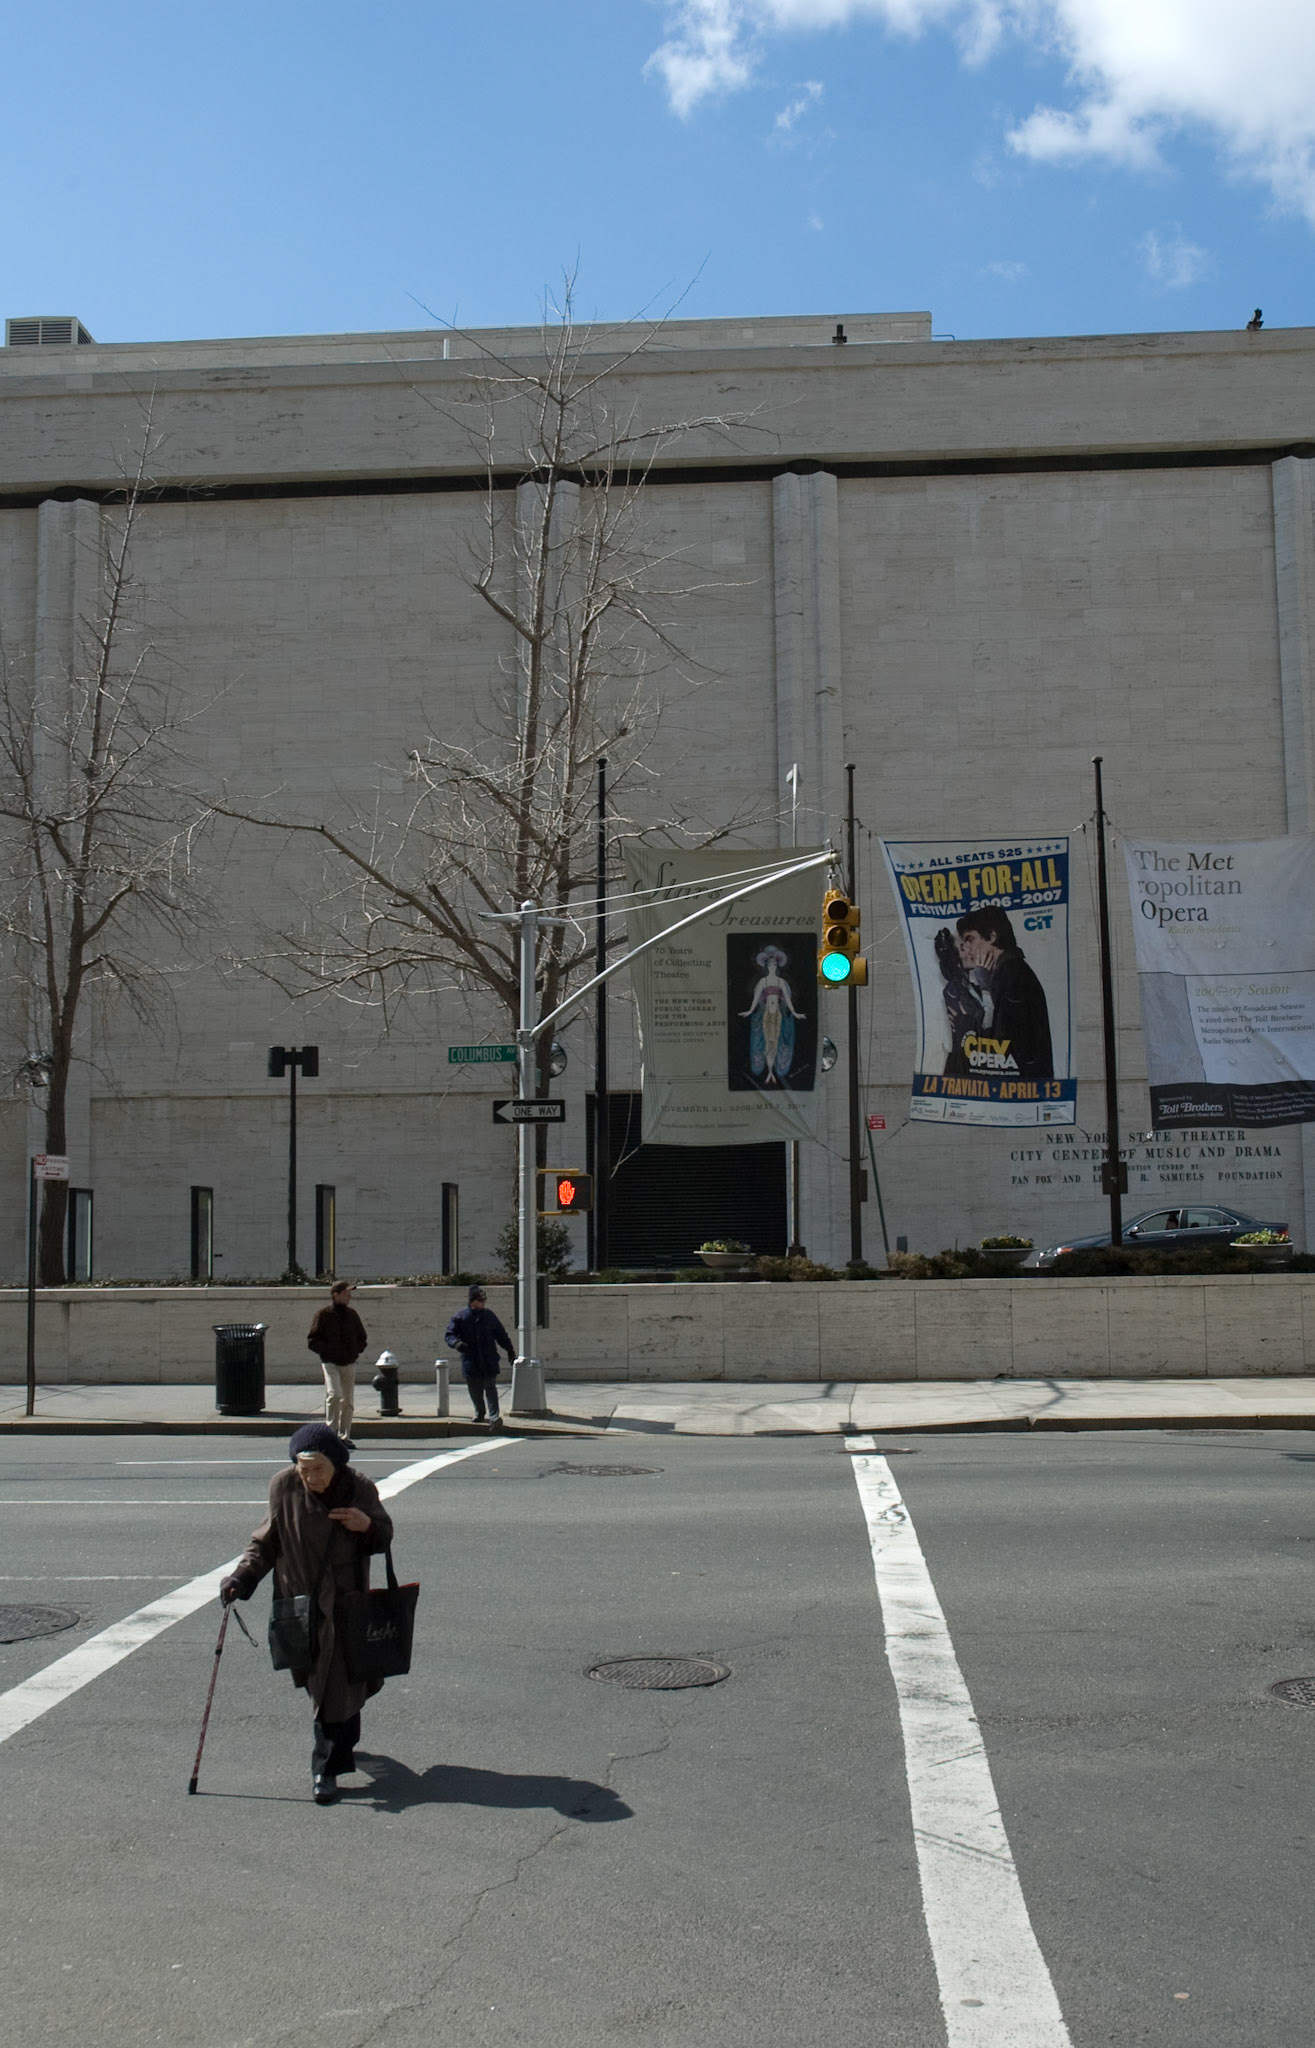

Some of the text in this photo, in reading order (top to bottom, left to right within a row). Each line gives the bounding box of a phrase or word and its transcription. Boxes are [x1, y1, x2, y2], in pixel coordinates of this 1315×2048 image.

[929, 847, 1022, 868] ALL SEATS $25
[1134, 850, 1235, 872] The Met
[633, 861, 724, 900] Stars
[900, 858, 1062, 903] OPERA-FOR-ALL
[1137, 874, 1242, 903] ropolitan
[710, 899, 816, 926] Treasures
[910, 902, 967, 916] FESTIVAL
[1141, 899, 1209, 928] Opera
[656, 946, 693, 954] 75 Years
[666, 959, 711, 968] Collecting
[654, 971, 689, 979] Theatre
[1248, 983, 1289, 996] Season
[1197, 1005, 1209, 1013] The
[1243, 1004, 1277, 1012] Broadcast
[1200, 1022, 1315, 1036] Metropolitan Opera International
[964, 1034, 1011, 1058] CITY
[1222, 1036, 1252, 1044] Network
[451, 1047, 502, 1062] COLUMBUS
[969, 1050, 1019, 1069] OPERA
[922, 1077, 1061, 1099] LA TRAVIATA APRIL 13
[514, 1106, 557, 1116] ONE WAY
[1160, 1104, 1179, 1114] Toll
[1180, 1102, 1223, 1112] Brothers
[1046, 1133, 1075, 1144] NEW
[1181, 1130, 1246, 1142] THEATER
[36, 1156, 46, 1164] NO
[1010, 1150, 1043, 1161] CITY
[1118, 1148, 1136, 1160] OF
[1145, 1147, 1191, 1159] MUSIC
[1199, 1146, 1225, 1158] AND
[1236, 1146, 1282, 1157] DRAMA
[1011, 1171, 1283, 1184] FAN FOX AND R. SAMUELS FOUNDATION
